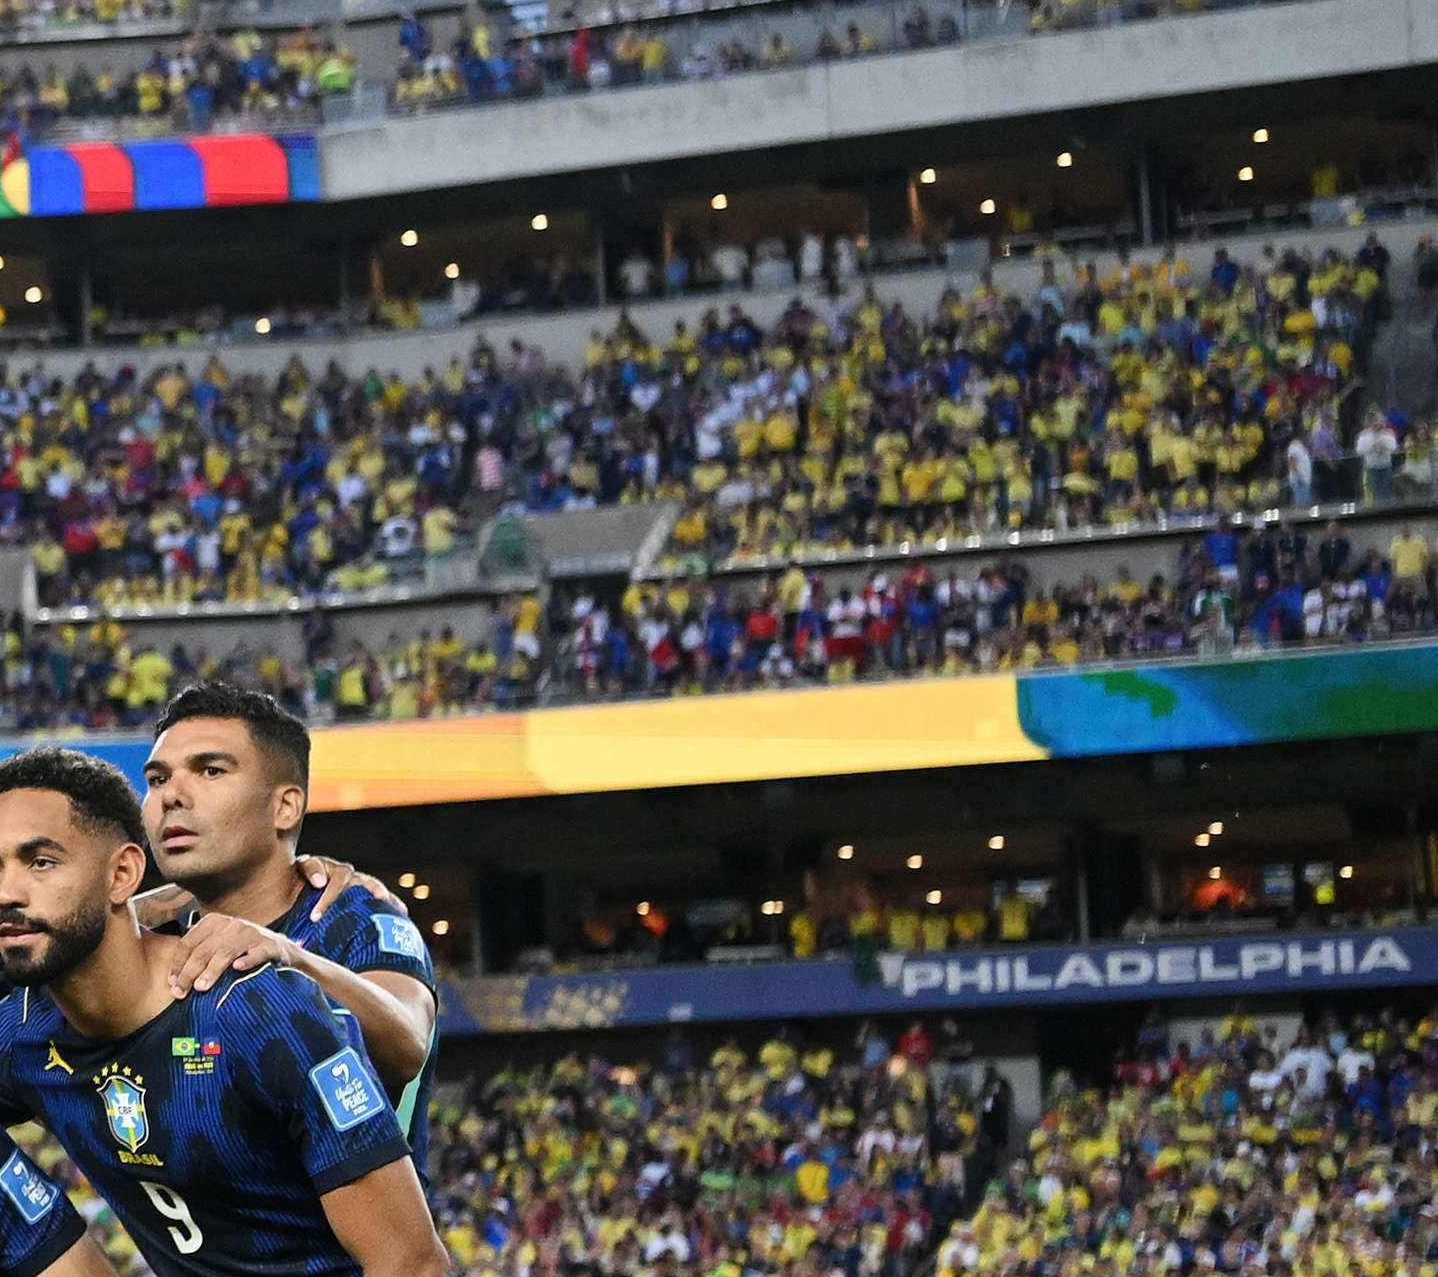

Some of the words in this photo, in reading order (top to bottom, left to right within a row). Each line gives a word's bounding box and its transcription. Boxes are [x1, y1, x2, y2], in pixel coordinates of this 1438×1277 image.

[902, 934, 1411, 996] PHILADELPHIA
[118, 1150, 164, 1166] BRASIL
[139, 1180, 204, 1255] 9
